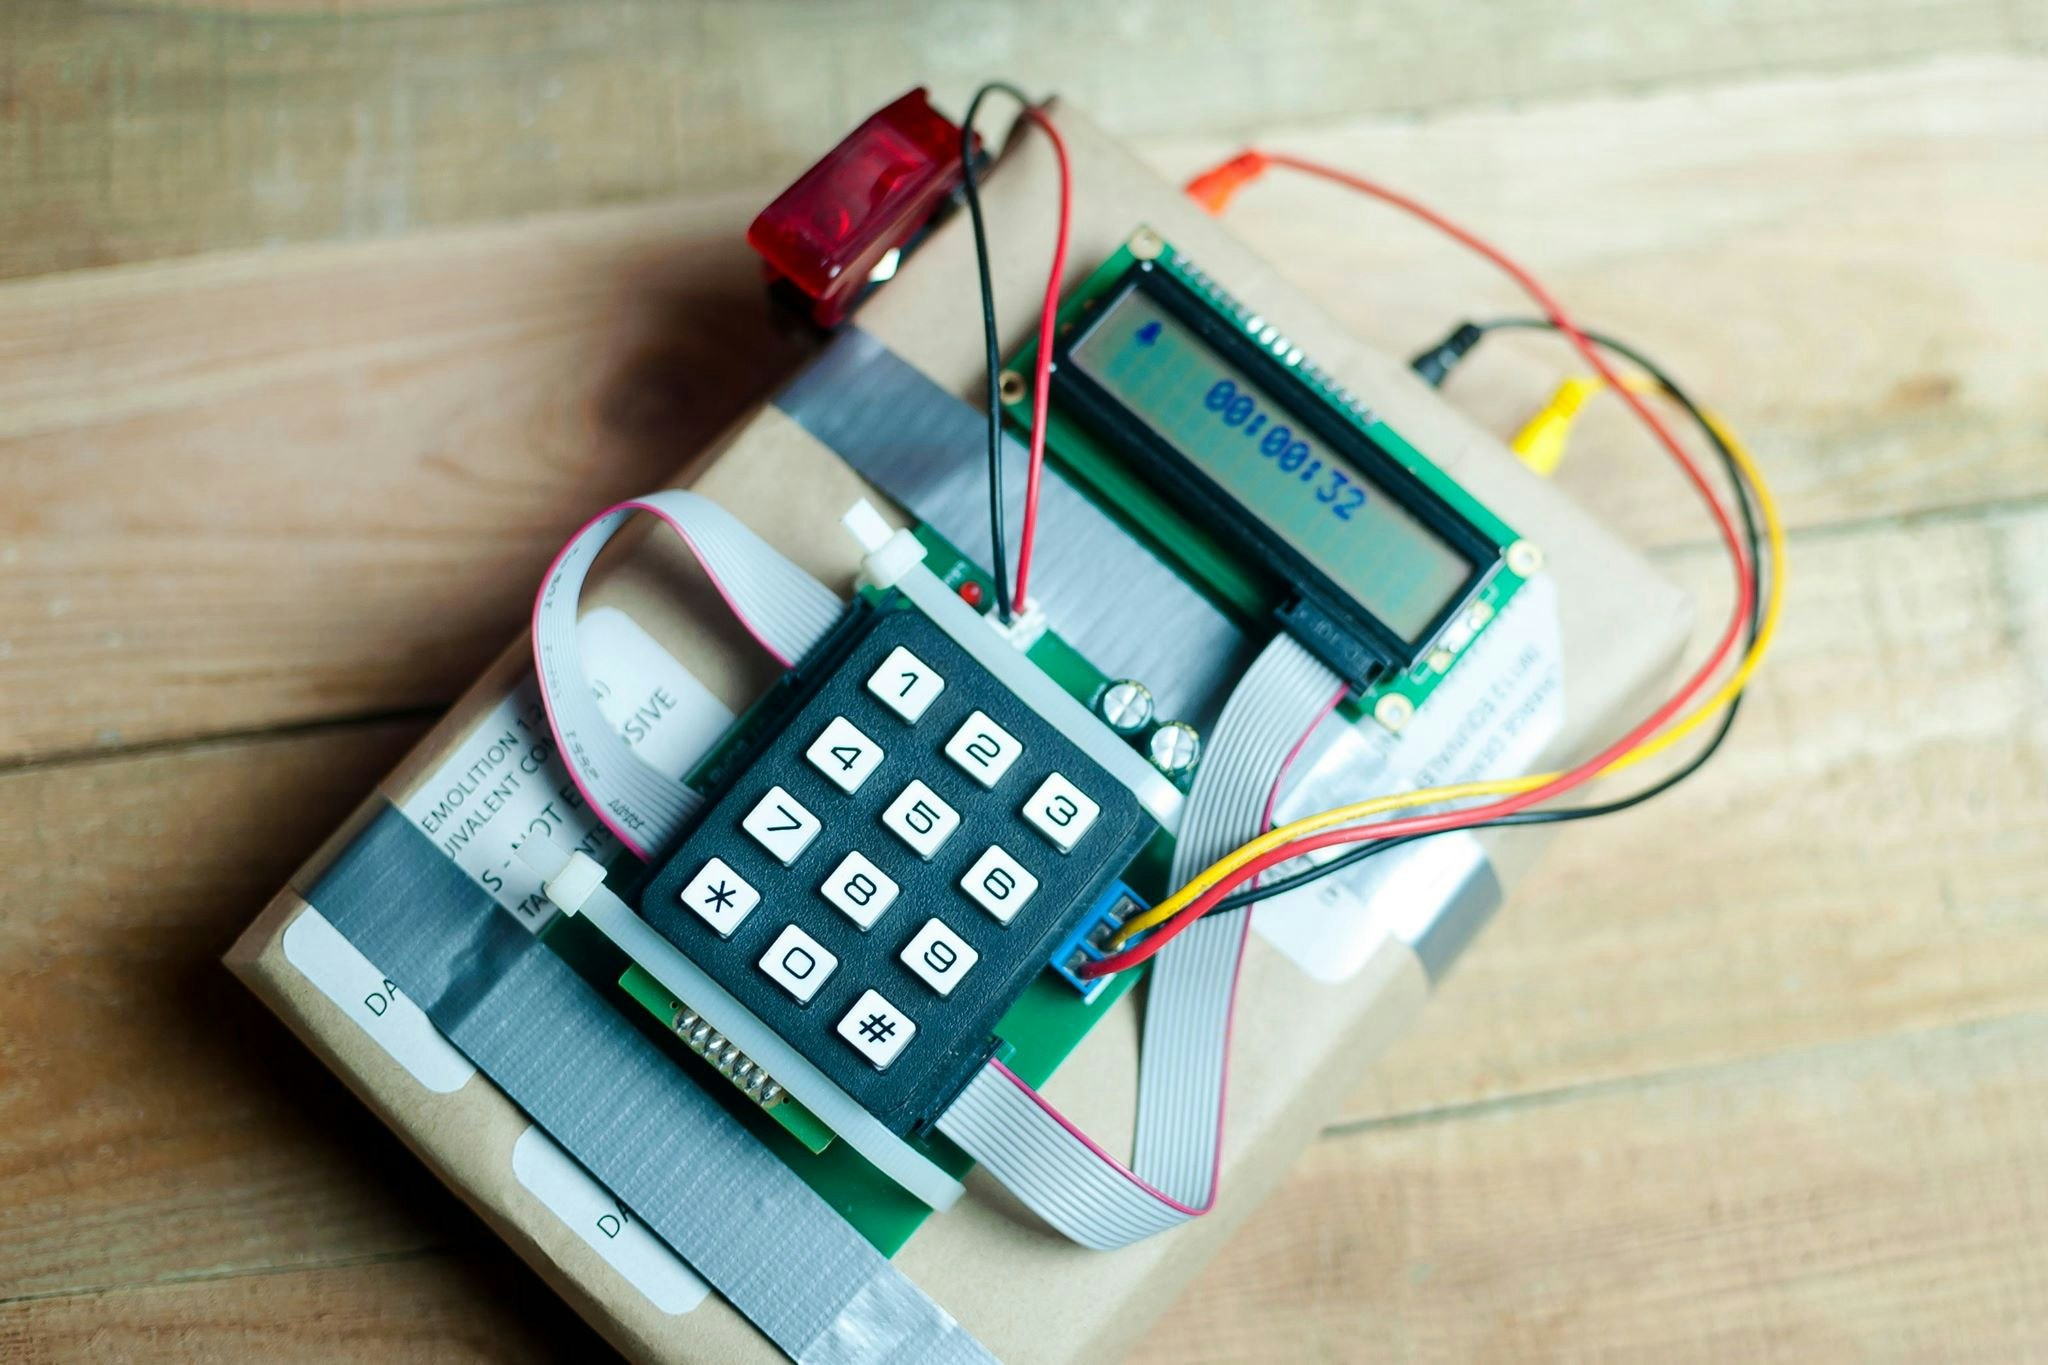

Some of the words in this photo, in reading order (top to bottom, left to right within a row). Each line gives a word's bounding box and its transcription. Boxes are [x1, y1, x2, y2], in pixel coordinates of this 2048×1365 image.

[1204, 379, 1367, 522] 00:00:32
[421, 730, 519, 834] EMOLITION
[899, 672, 919, 698] 1
[965, 733, 1001, 768] 2
[1045, 795, 1078, 827] 3
[766, 804, 803, 832] 7
[843, 873, 877, 906] 8
[923, 940, 958, 974] 9
[830, 746, 862, 771] 4
[905, 799, 941, 835] 5
[983, 867, 1016, 901] 6
[364, 979, 398, 1017] DA
[858, 1013, 896, 1043] #
